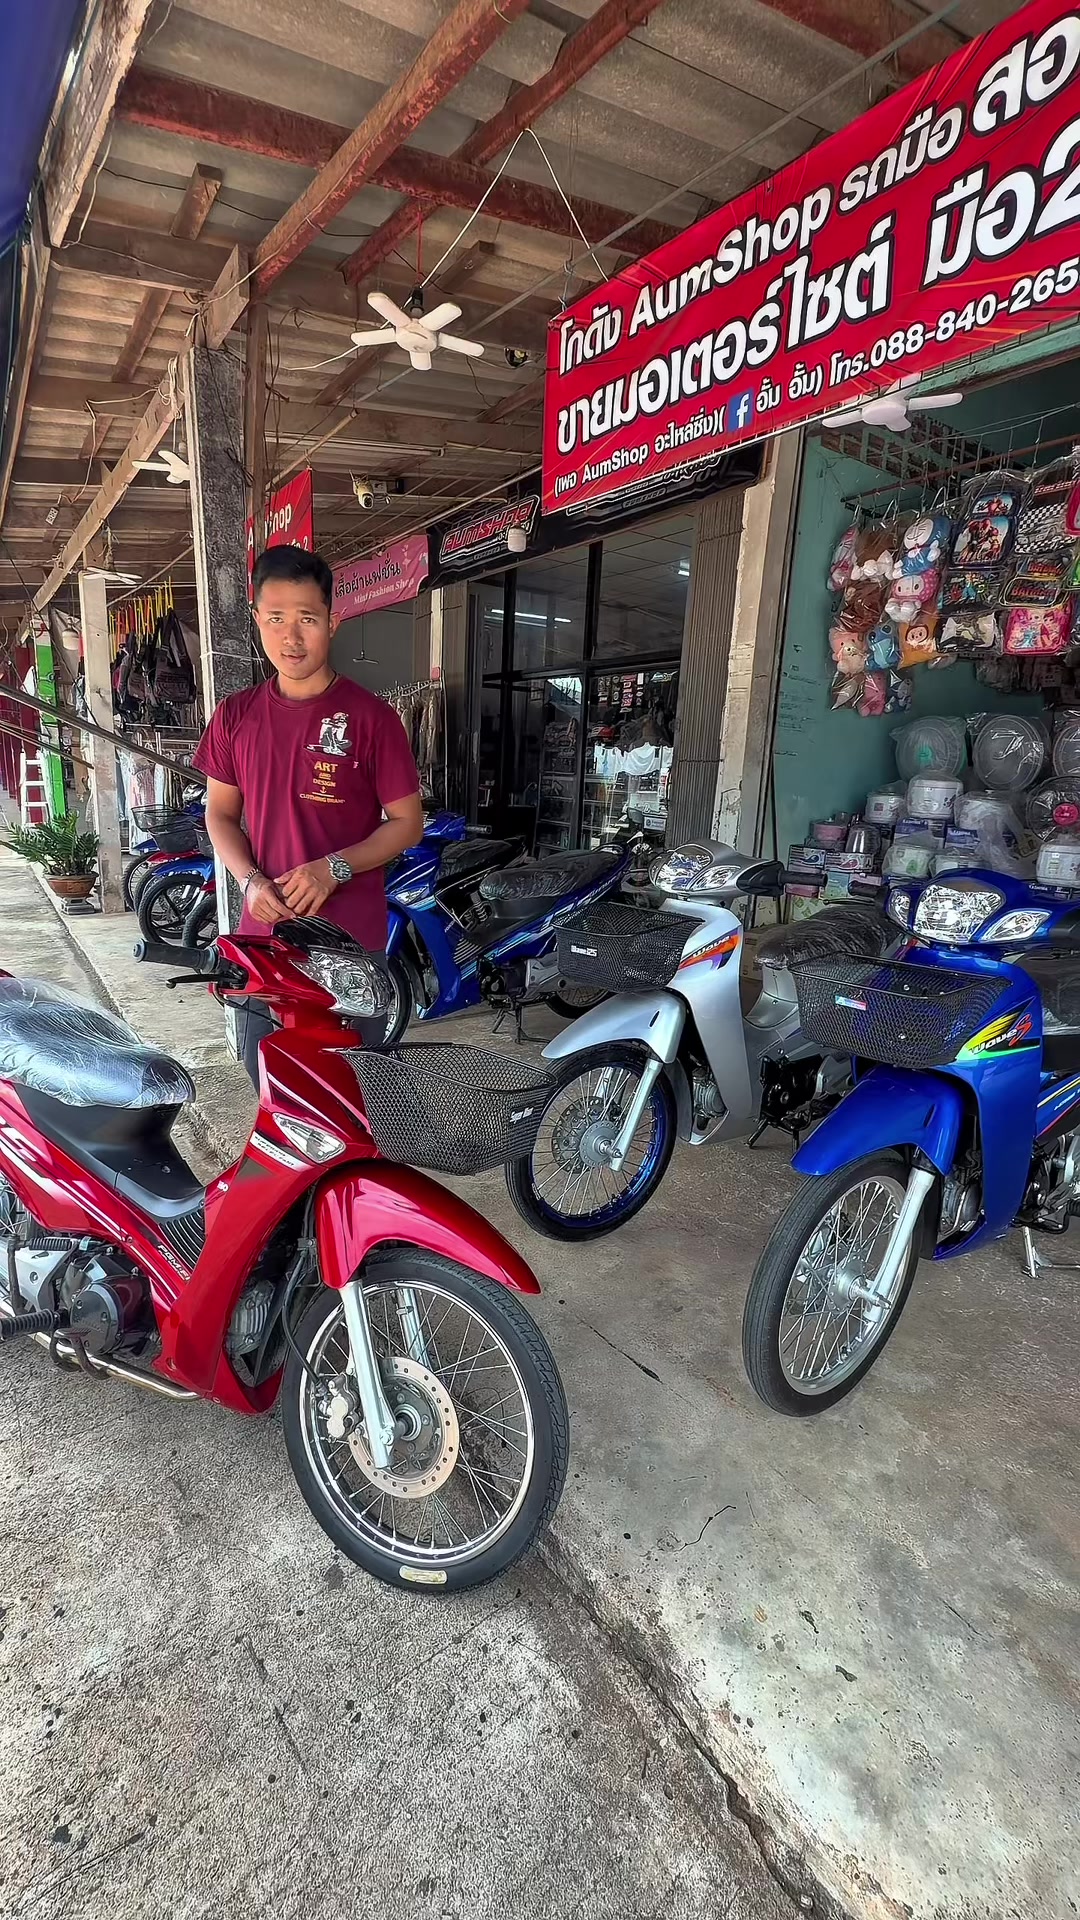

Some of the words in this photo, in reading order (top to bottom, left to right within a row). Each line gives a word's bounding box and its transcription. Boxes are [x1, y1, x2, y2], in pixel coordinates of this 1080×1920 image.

[628, 187, 831, 337] AumShop
[838, 104, 964, 213] รถมือ
[581, 442, 649, 485] AumShop
[828, 256, 1080, 387] โทร.088-840-265
[368, 584, 395, 600] Fashion
[314, 761, 338, 773] ART
[312, 778, 337, 787] DESIGN
